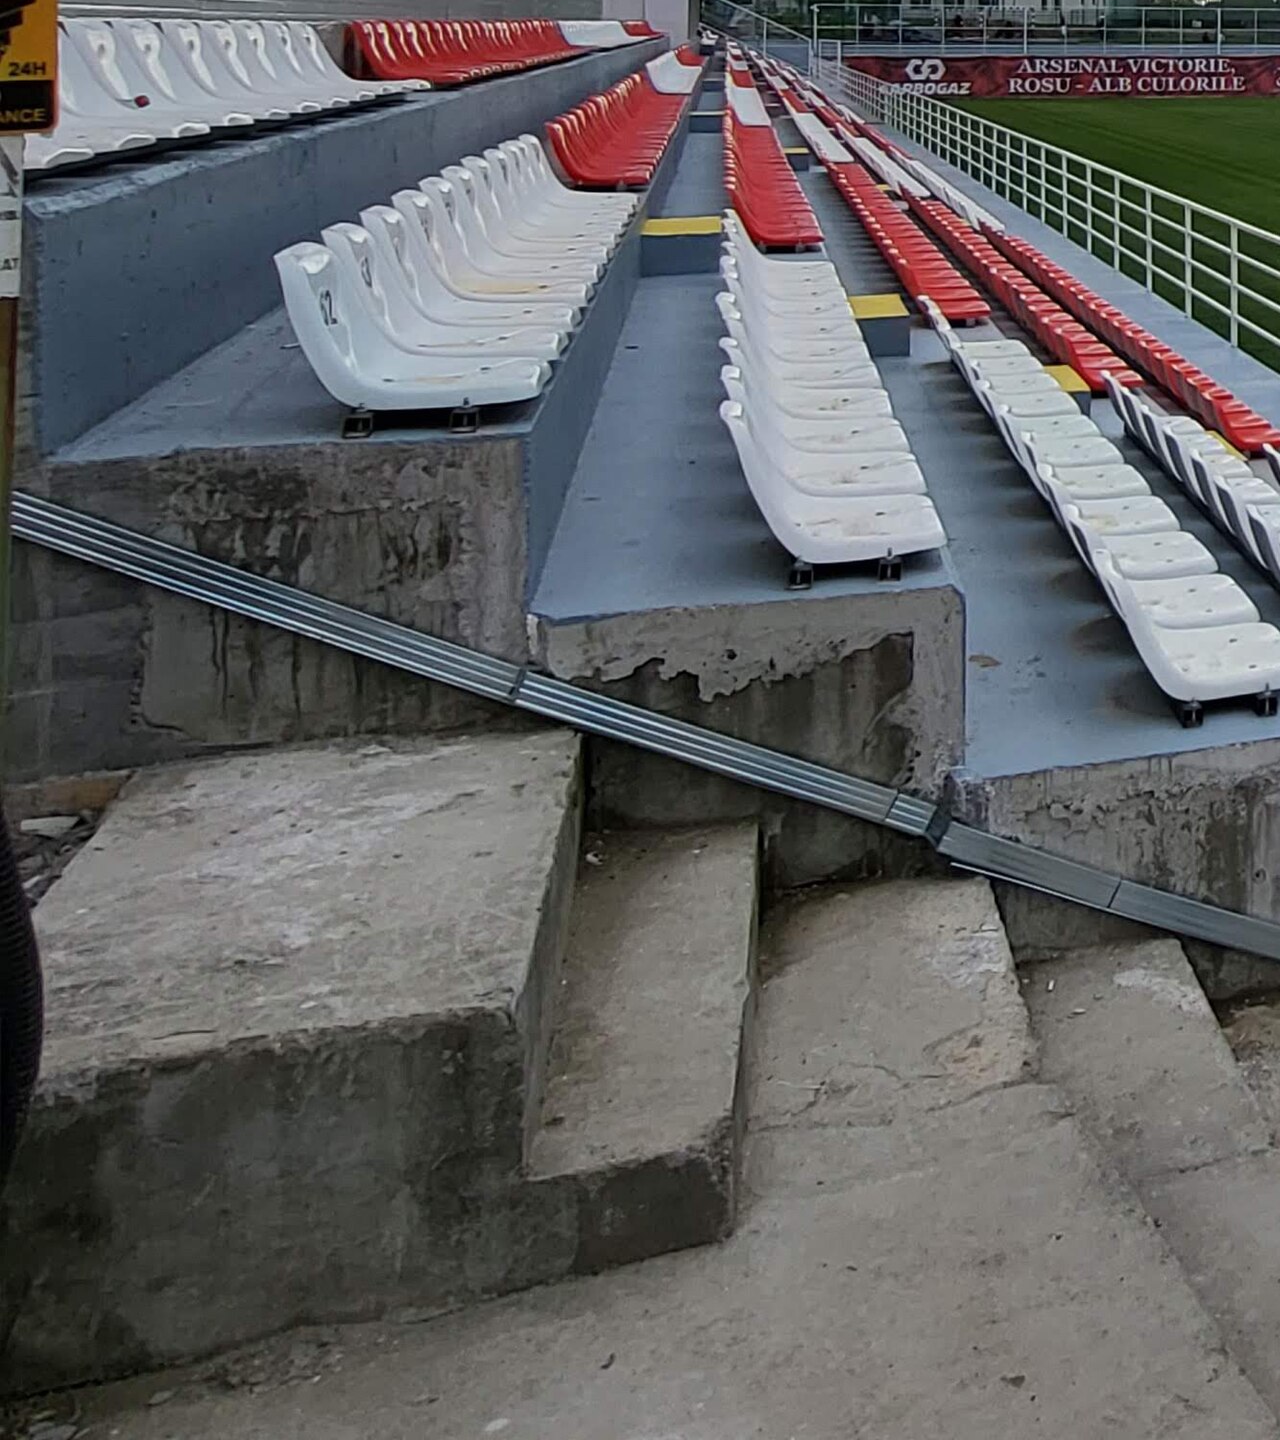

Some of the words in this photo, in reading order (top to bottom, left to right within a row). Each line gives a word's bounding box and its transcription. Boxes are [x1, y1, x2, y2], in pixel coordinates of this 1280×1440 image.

[9, 62, 46, 76] 24H
[1017, 58, 1123, 73] ARSENAL
[1127, 58, 1236, 75] VICTORIE,
[1009, 76, 1071, 94] ROSU
[1088, 76, 1132, 93] ALB
[1137, 76, 1246, 92] CULORILE
